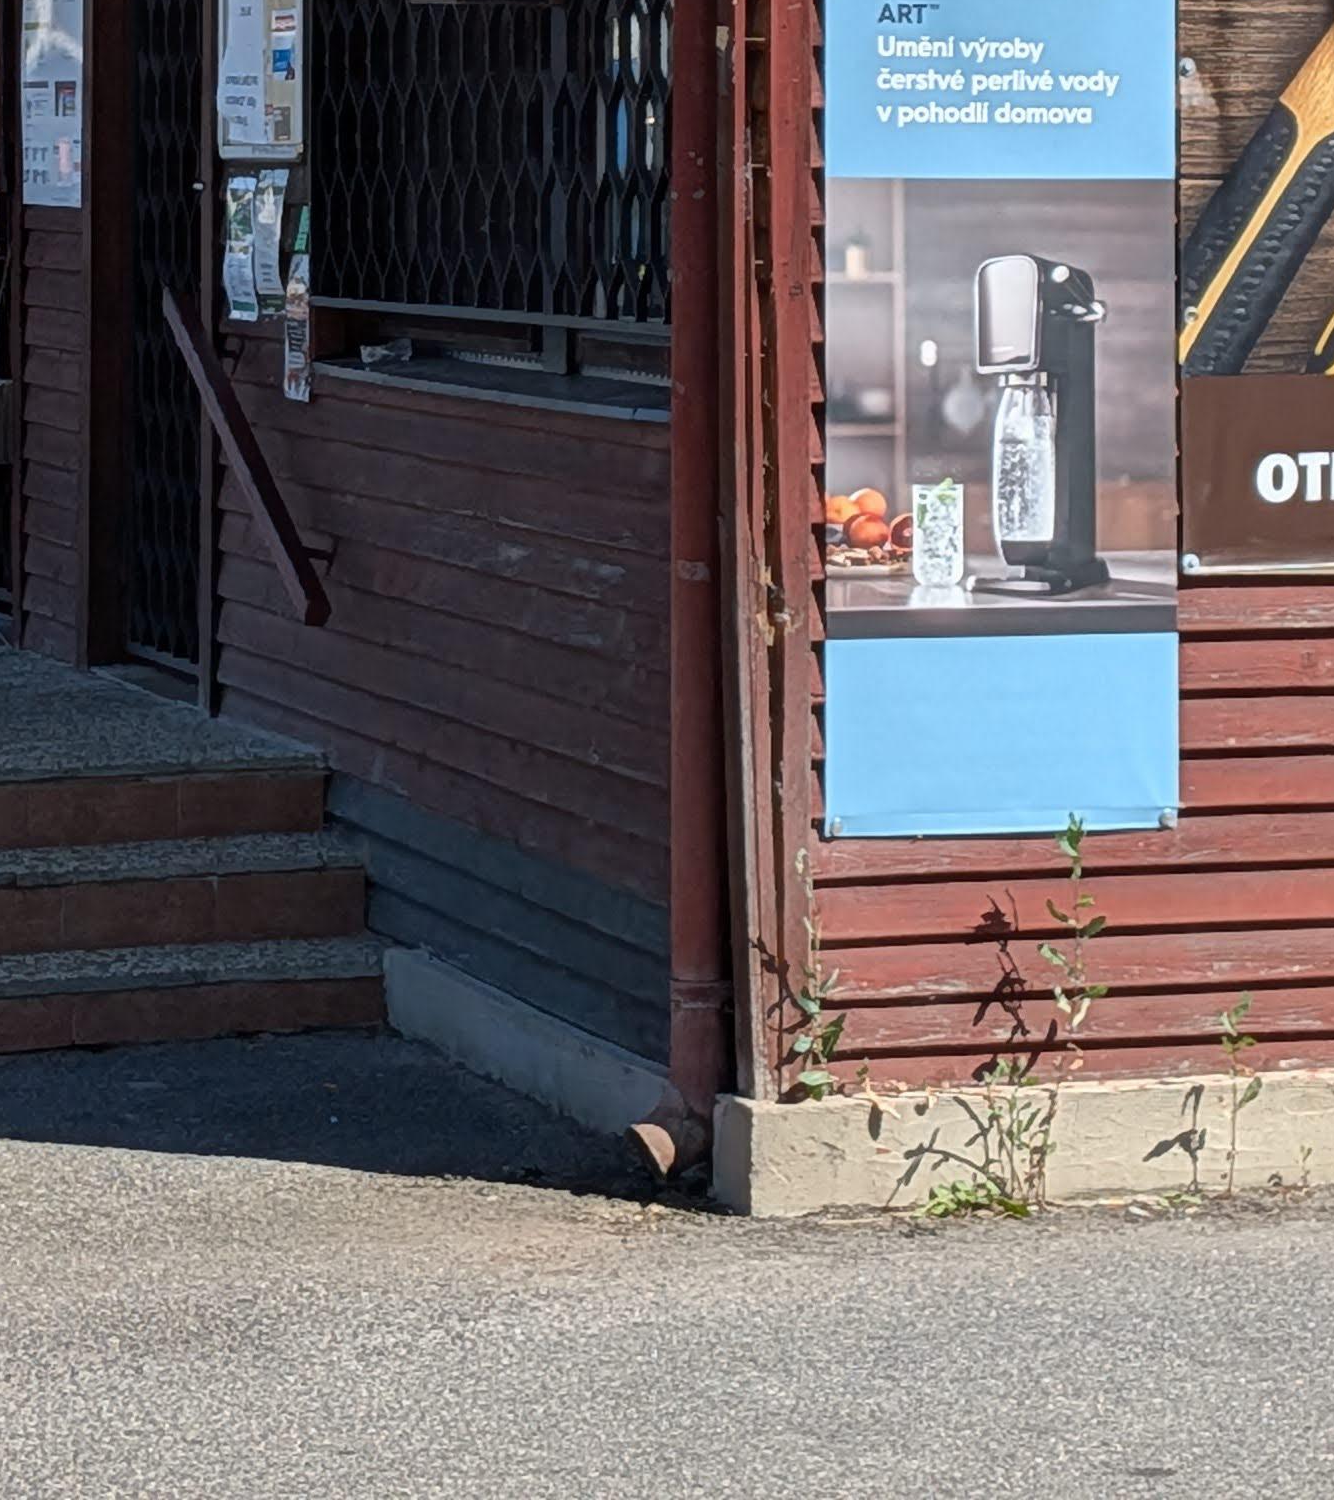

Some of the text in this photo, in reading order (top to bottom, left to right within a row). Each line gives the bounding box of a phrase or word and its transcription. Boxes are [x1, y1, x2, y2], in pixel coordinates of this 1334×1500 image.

[876, 34, 1045, 65] Umění výroby
[875, 66, 1121, 98] čerstvé perlivé vody
[875, 101, 1093, 129] v pohodlí domova
